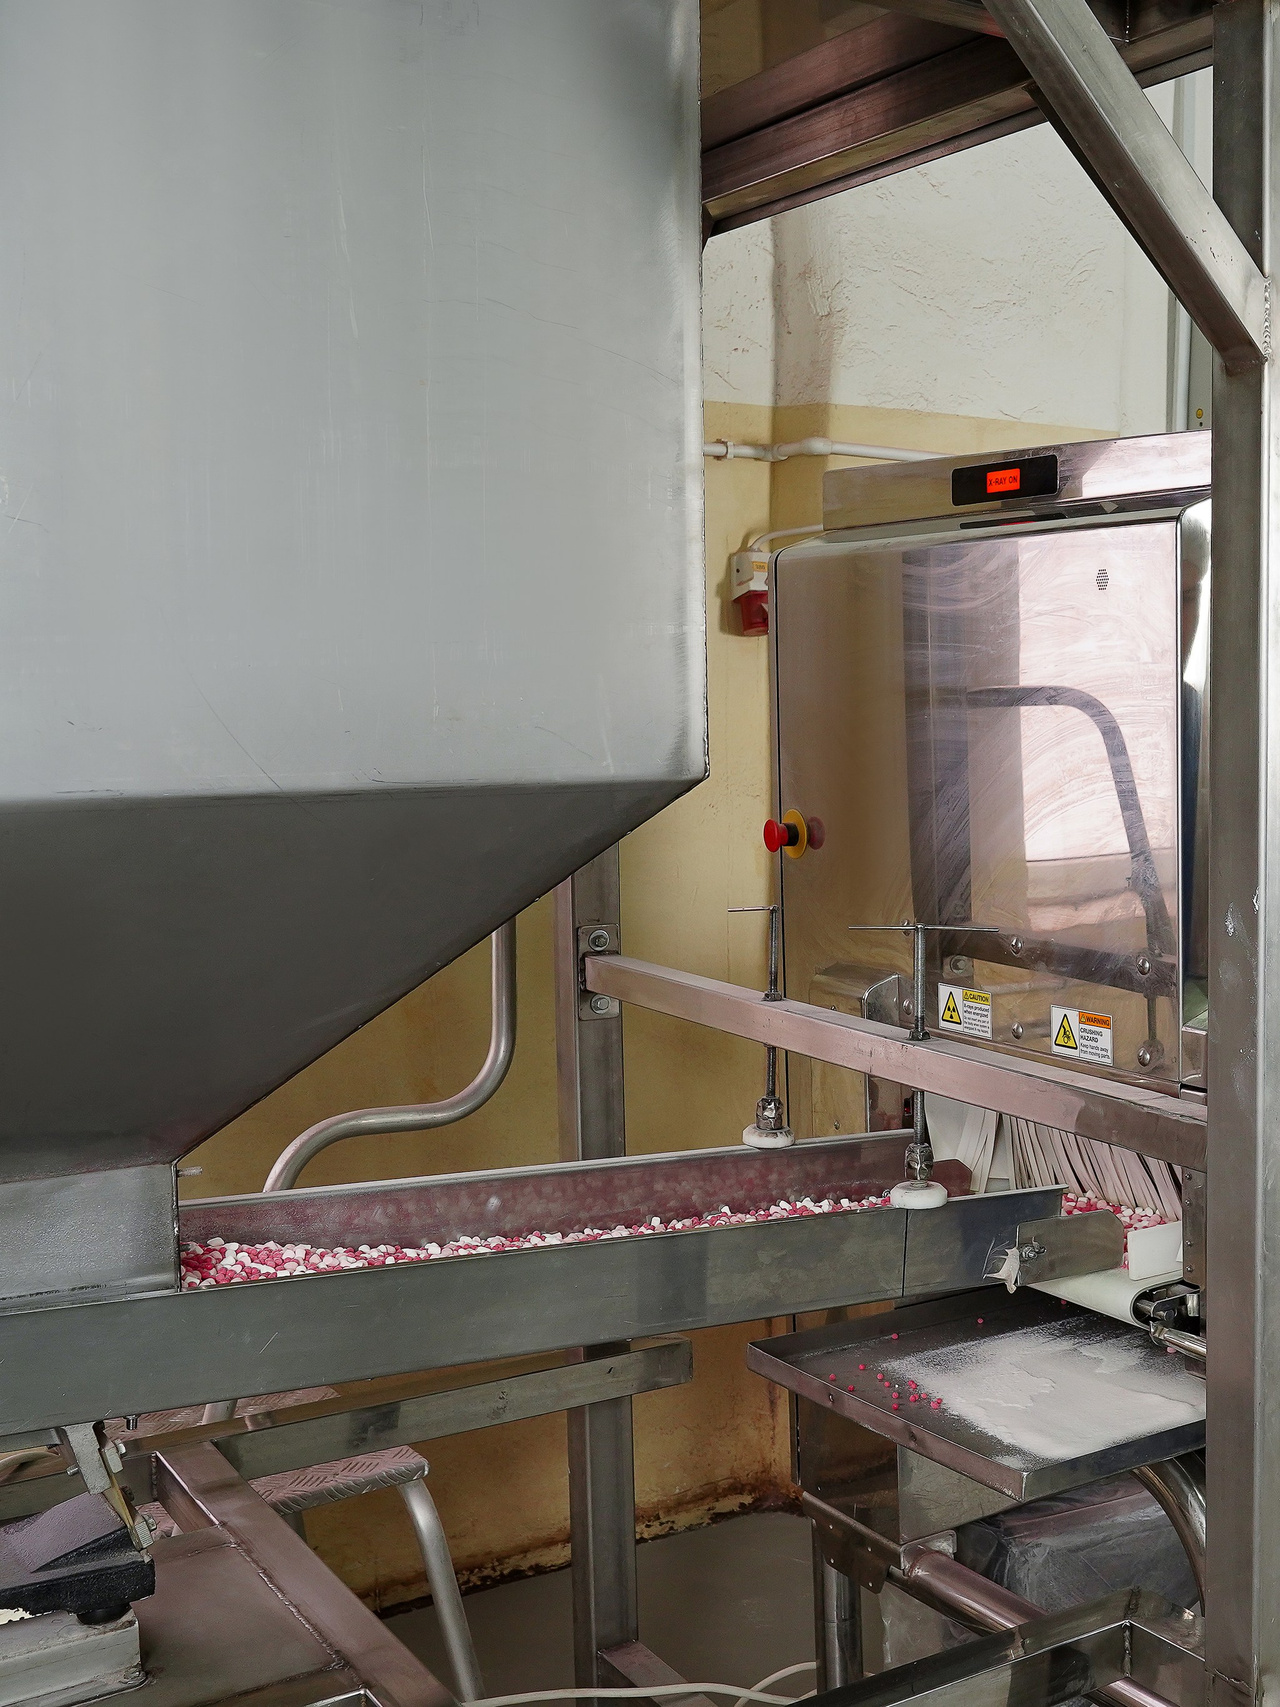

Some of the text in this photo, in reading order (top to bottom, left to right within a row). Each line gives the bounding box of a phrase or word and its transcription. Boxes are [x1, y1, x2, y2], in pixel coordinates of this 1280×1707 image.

[989, 476, 1018, 486] X-RAY ON
[969, 993, 989, 1002] CAUTION
[1086, 1015, 1110, 1026] WARNING
[1080, 1027, 1103, 1037] CRUSHING
[1080, 1035, 1098, 1043] HAZARD
